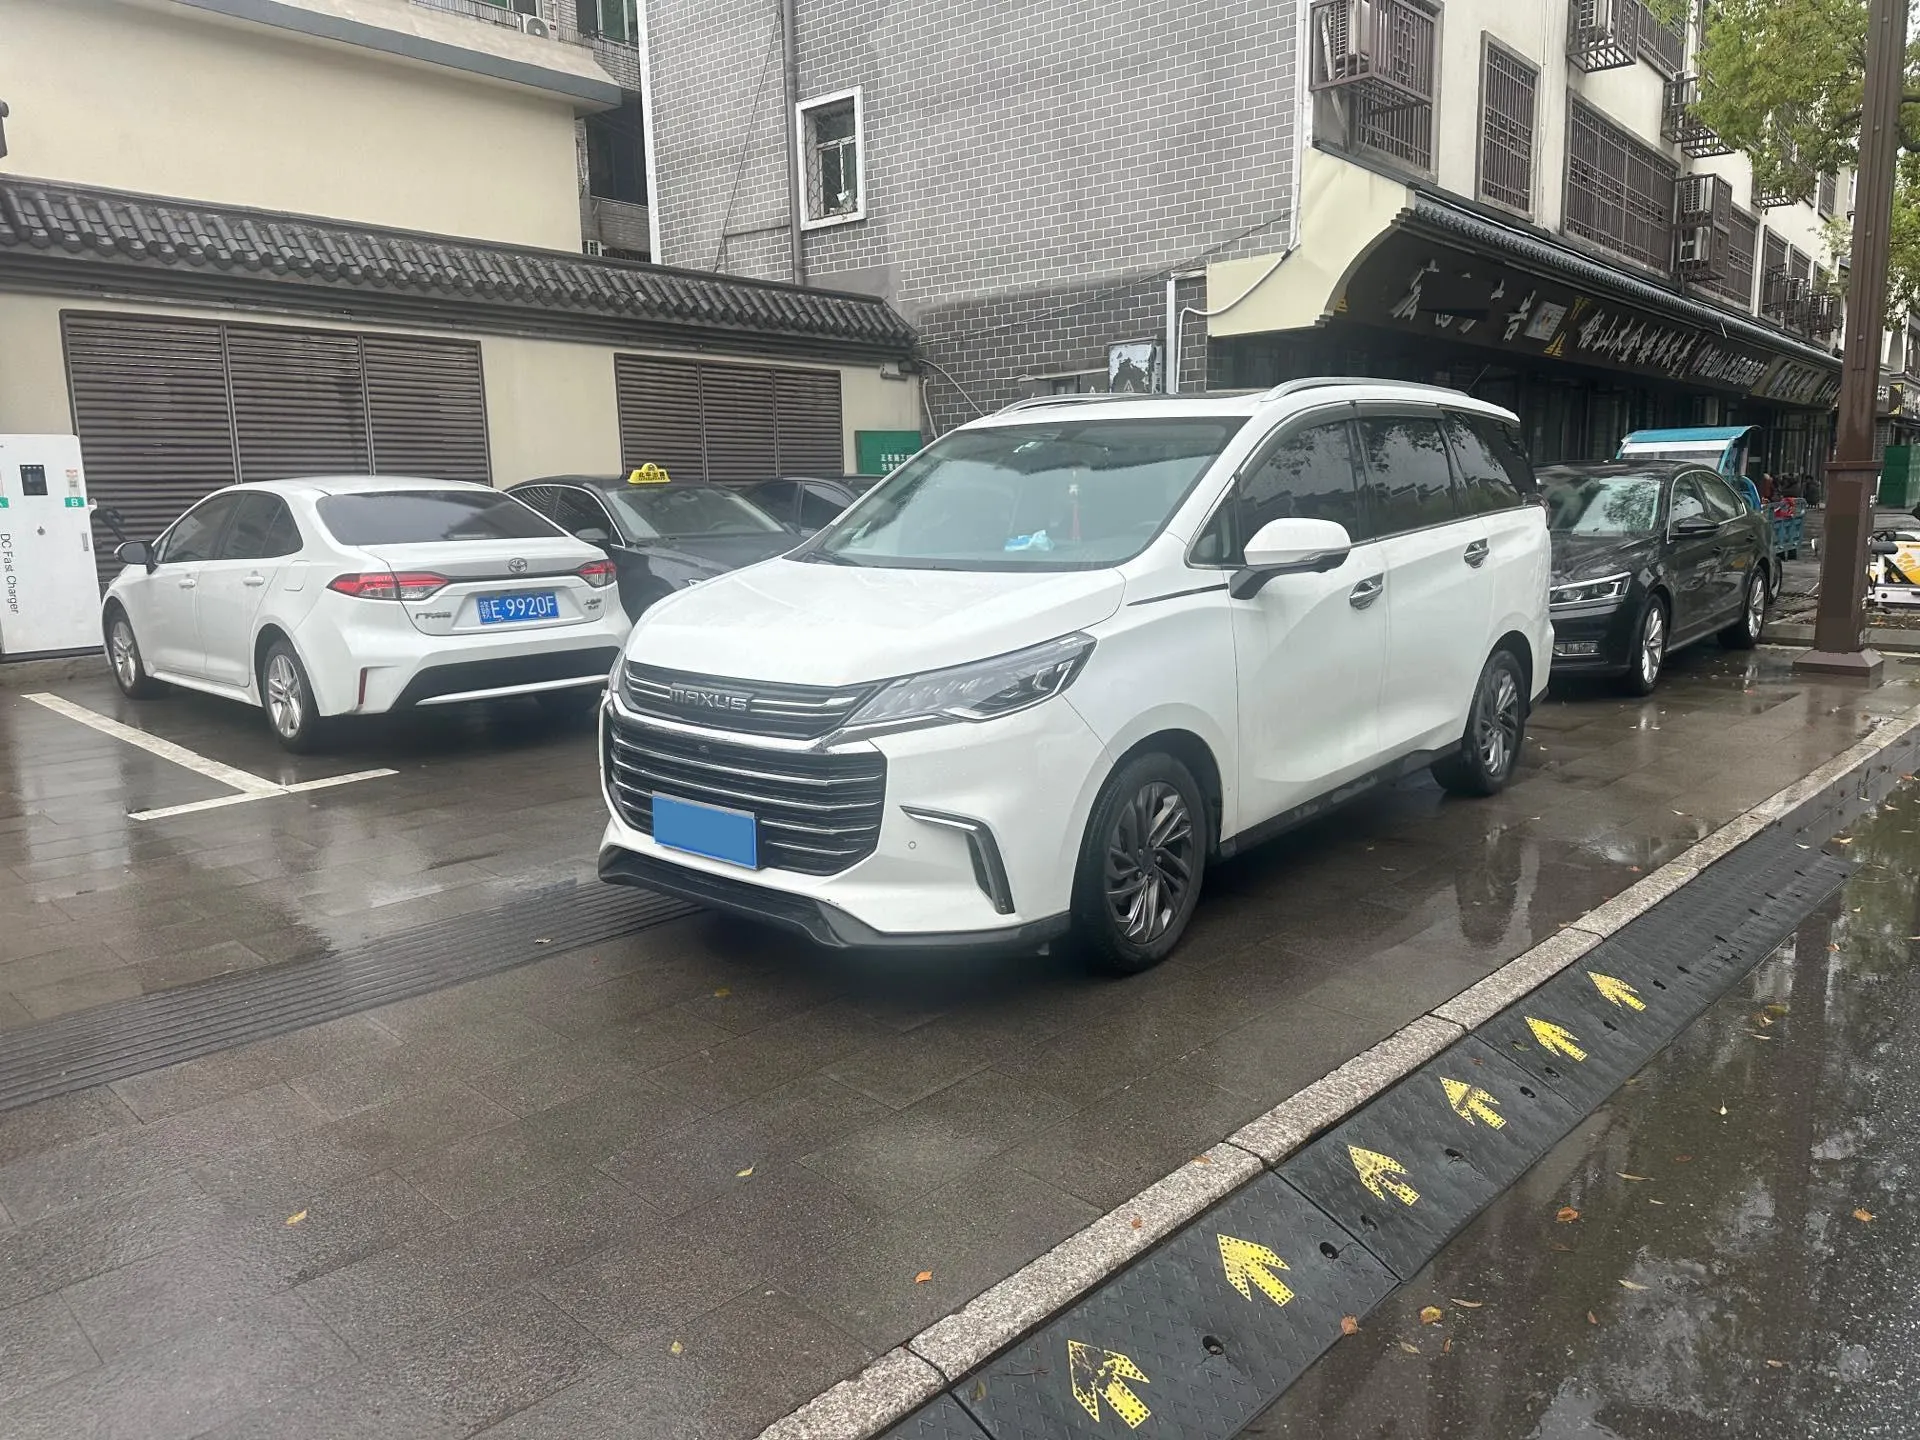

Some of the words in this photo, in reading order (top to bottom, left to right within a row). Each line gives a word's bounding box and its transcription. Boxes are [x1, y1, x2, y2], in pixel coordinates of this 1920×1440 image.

[0, 533, 12, 549] DC
[3, 551, 14, 573] Fast
[6, 575, 19, 615] Charger
[670, 689, 747, 712] MAXUS
